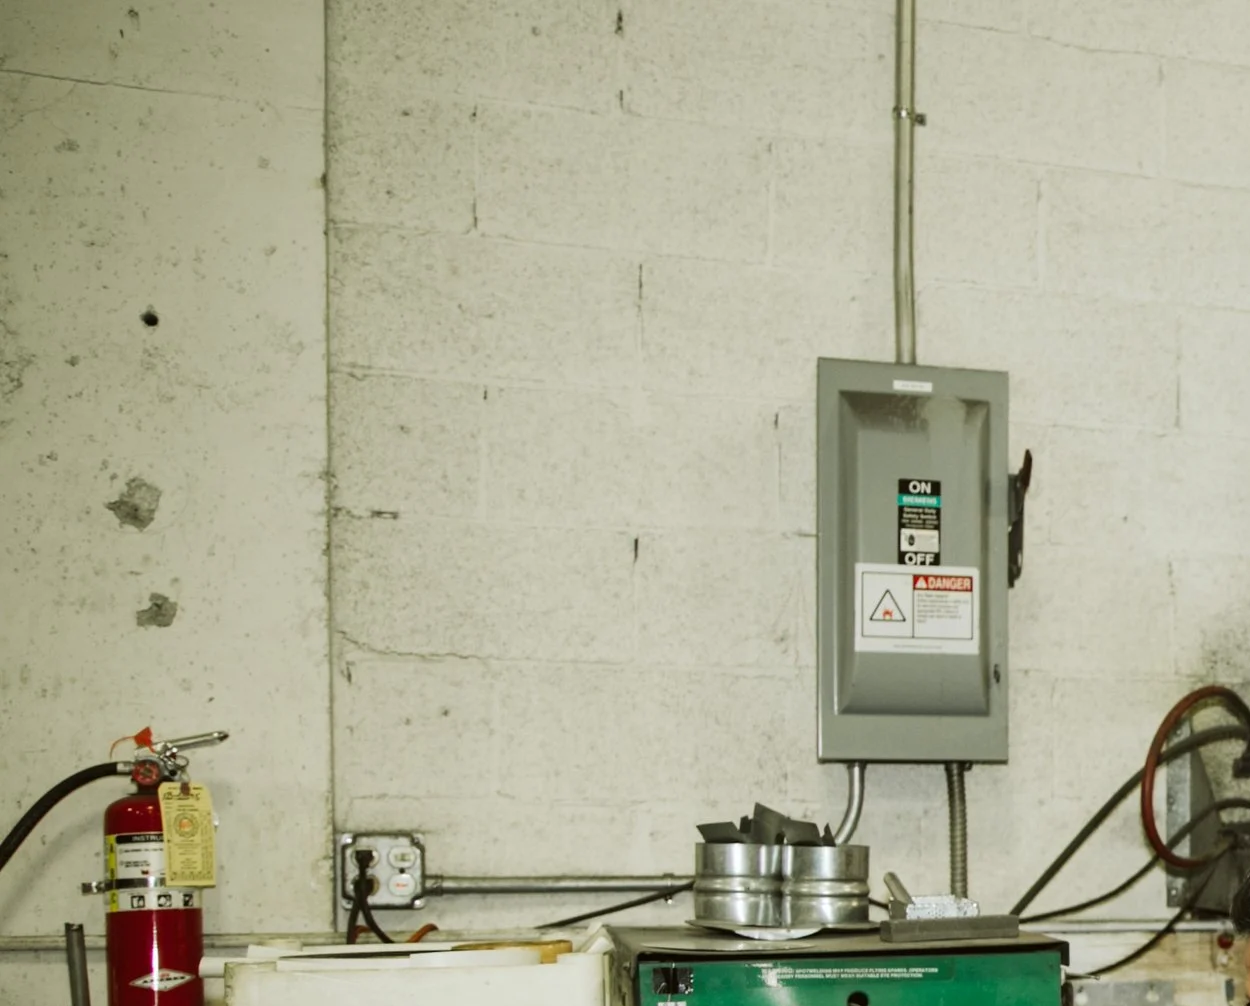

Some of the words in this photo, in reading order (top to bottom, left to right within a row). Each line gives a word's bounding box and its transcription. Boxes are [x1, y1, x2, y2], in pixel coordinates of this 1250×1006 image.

[908, 480, 932, 494] ON
[904, 552, 935, 566] OFF
[928, 576, 971, 590] DANGER
